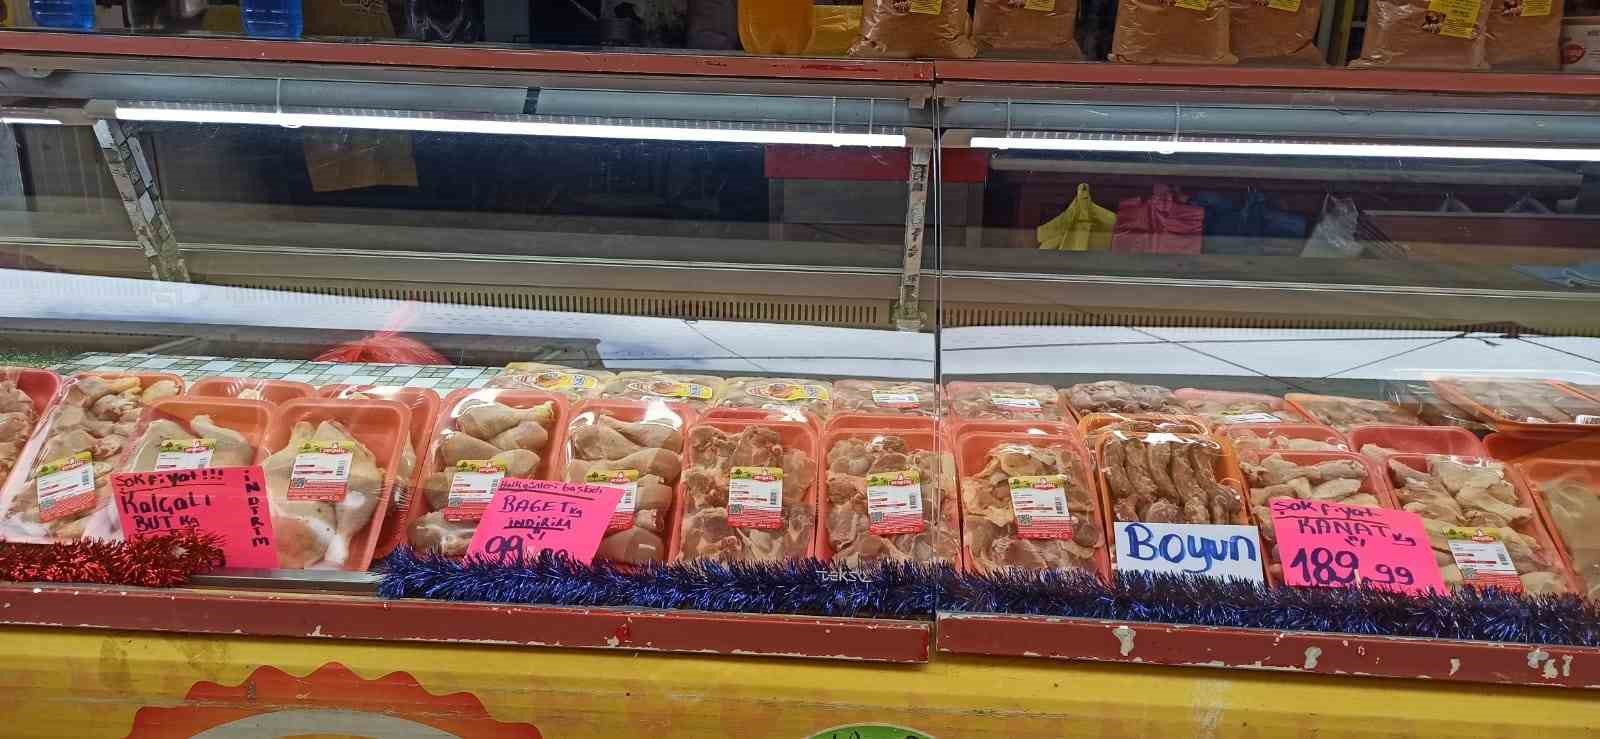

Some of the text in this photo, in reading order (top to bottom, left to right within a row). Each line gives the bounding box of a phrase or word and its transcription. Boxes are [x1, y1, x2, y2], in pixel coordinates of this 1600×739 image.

[133, 515, 172, 531] BUT
[1298, 518, 1390, 537] KANAT
[1124, 522, 1257, 574] Boyun
